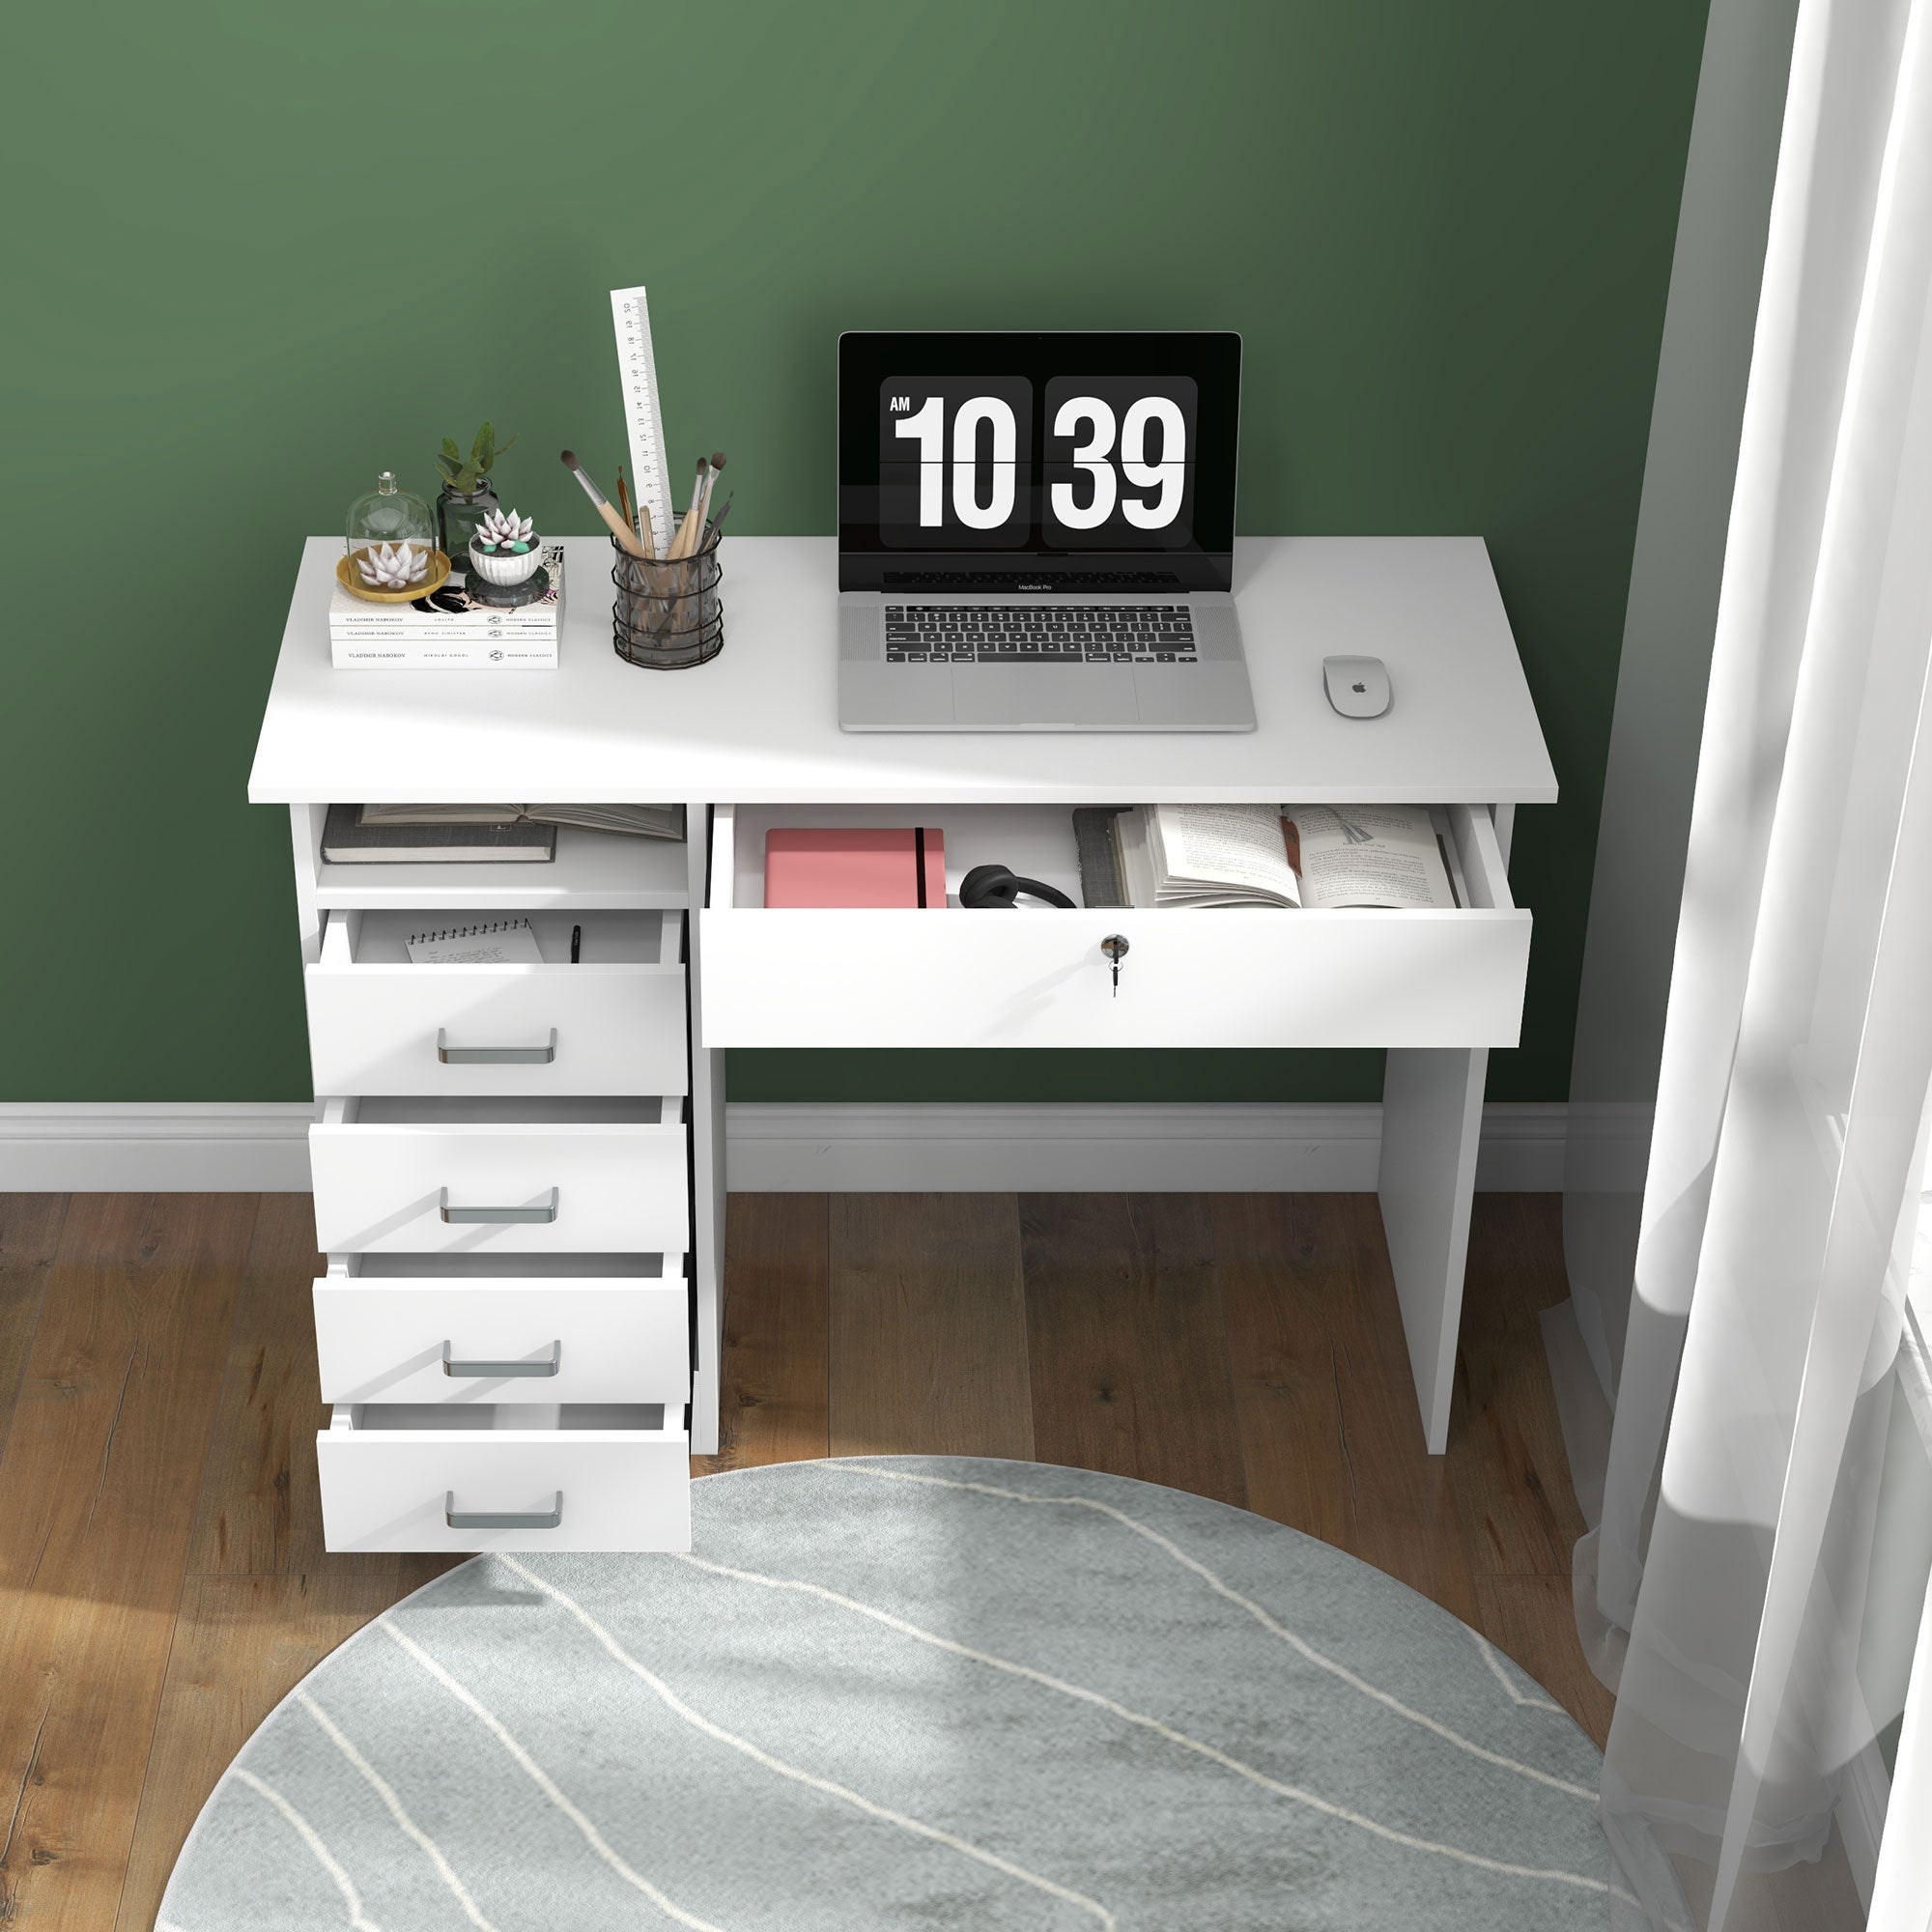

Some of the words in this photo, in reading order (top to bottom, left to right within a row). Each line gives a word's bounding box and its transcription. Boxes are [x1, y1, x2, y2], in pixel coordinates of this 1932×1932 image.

[890, 396, 910, 412] AM
[894, 396, 1016, 529] 10
[1051, 396, 1187, 529] 39
